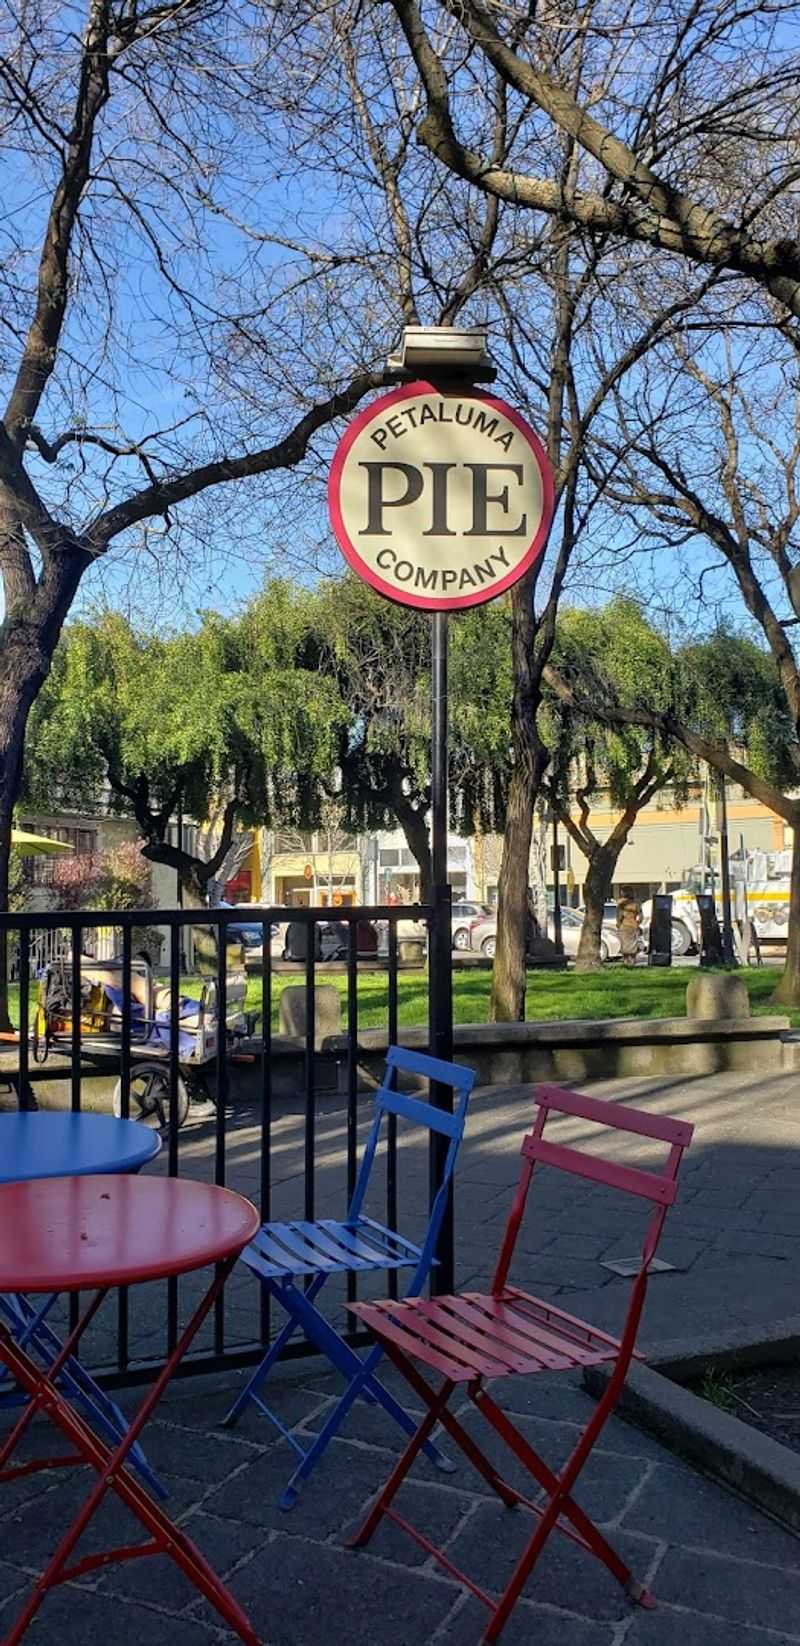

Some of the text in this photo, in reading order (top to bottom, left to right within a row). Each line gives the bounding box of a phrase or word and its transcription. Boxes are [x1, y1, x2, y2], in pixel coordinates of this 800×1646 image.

[371, 402, 515, 452] PETALUMA
[358, 461, 527, 536] PIE
[376, 546, 511, 591] COMPANY
